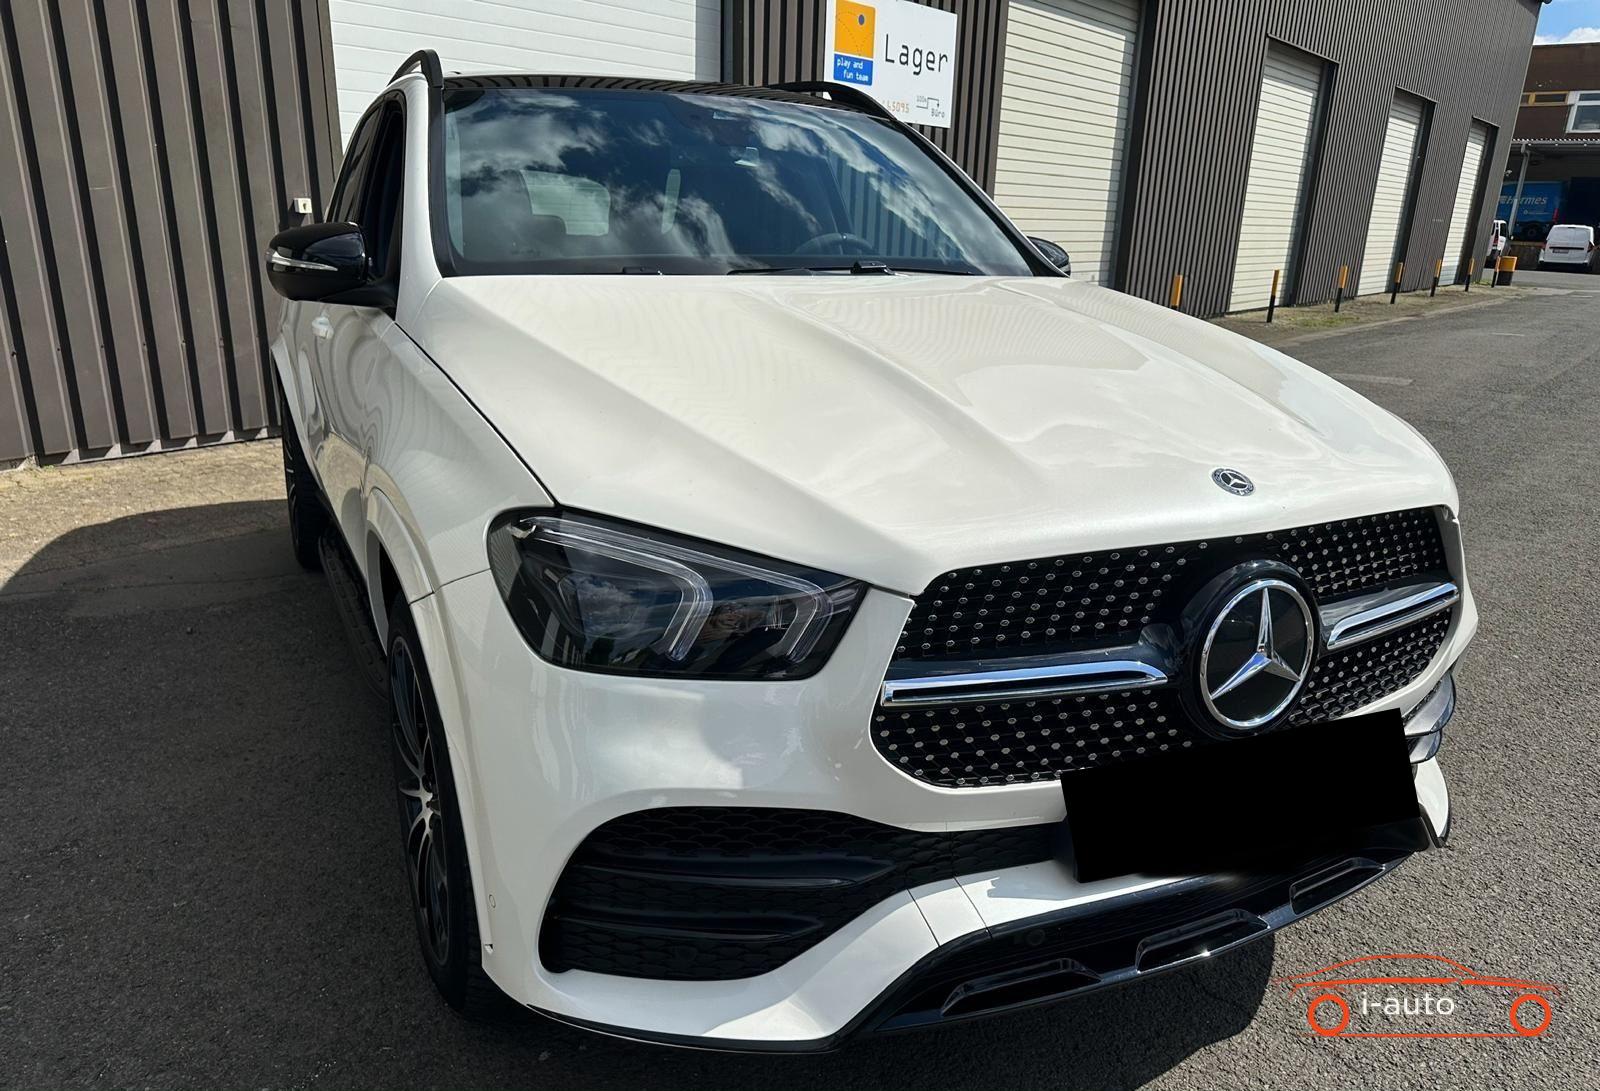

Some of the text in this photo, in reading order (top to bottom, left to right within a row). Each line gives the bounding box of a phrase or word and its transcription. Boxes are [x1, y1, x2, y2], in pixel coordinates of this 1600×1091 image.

[885, 33, 948, 76] Lager
[836, 57, 864, 70] play and
[843, 69, 869, 82] fun team
[1506, 196, 1548, 205] Hrmes
